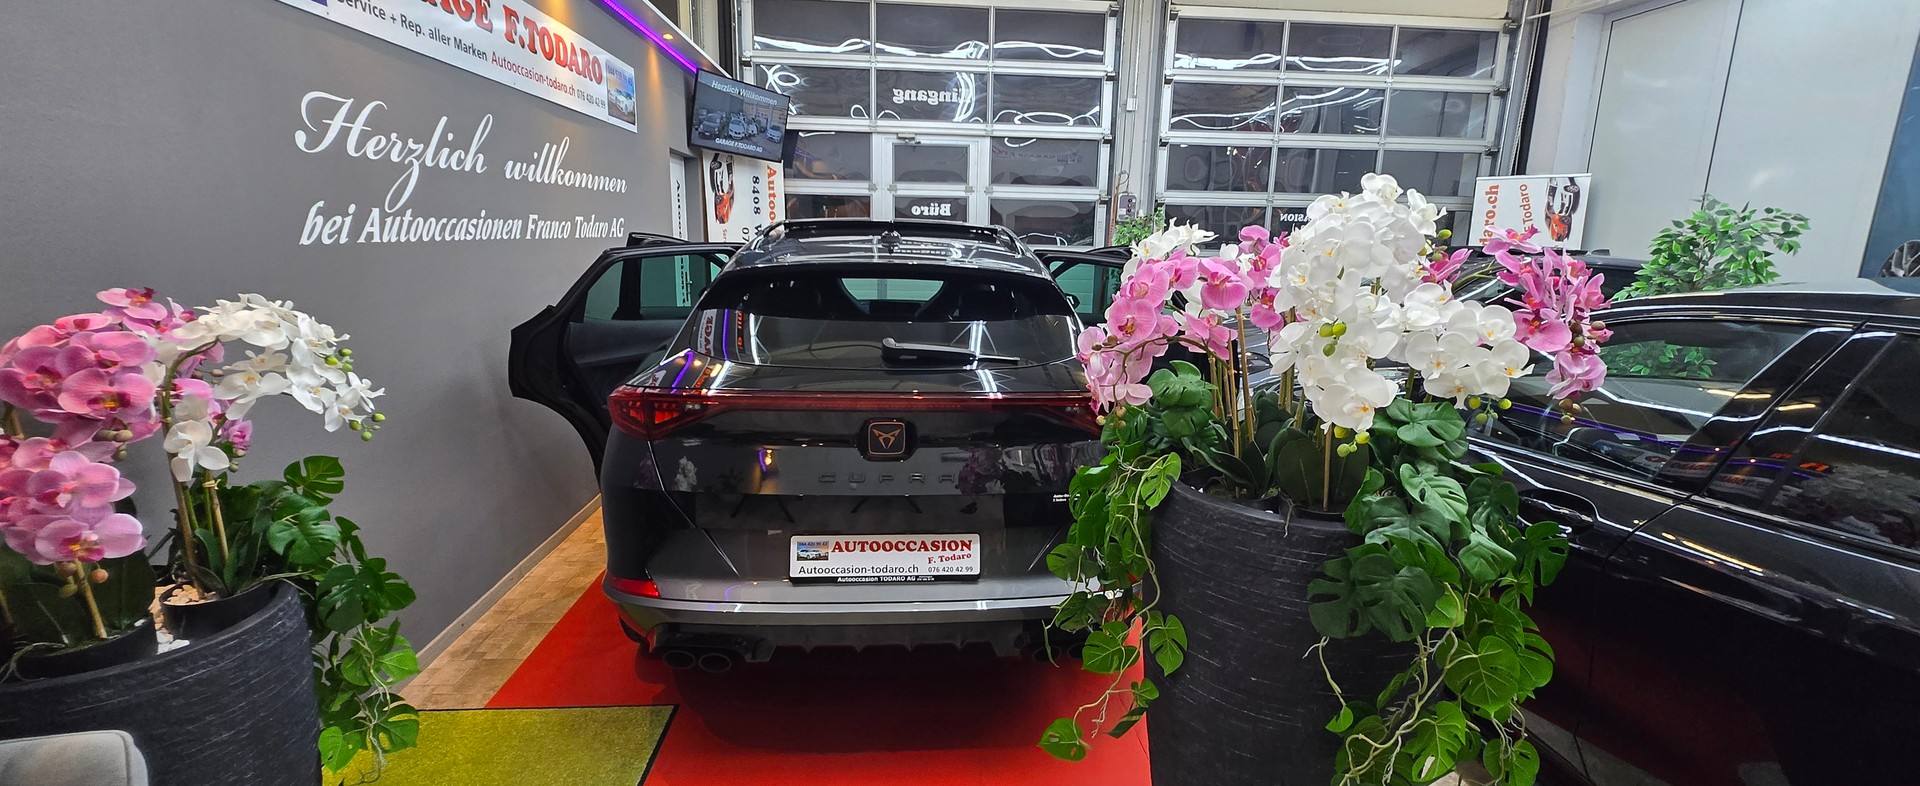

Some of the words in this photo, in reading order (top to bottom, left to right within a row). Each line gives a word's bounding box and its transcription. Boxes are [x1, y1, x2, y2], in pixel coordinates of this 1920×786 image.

[337, 0, 386, 21] ervice
[389, 13, 397, 24] +
[400, 13, 425, 37] Rep.
[428, 27, 451, 47] aller
[454, 36, 488, 61] Marken
[491, 51, 576, 97] Autooccasion-todaro.ch
[502, 4, 603, 85] F.TODARO
[711, 80, 740, 95] Herzlich
[740, 88, 778, 106] Willkommen
[294, 91, 493, 213] Herzlich
[504, 136, 628, 193] willkommen
[715, 137, 734, 147] GARAGE
[752, 176, 760, 215] 8408
[767, 165, 777, 225] Autoo
[1519, 184, 1533, 224] Todaro
[299, 200, 356, 245] bei
[357, 207, 523, 243] Autooccasionen
[526, 214, 571, 240] Franco
[575, 214, 608, 239] Todaro
[609, 217, 625, 238] AG
[819, 472, 956, 483] CUPRA
[831, 540, 972, 553] AUTOOCCASION
[928, 556, 937, 565] F.
[938, 552, 972, 563] Todaro
[798, 564, 919, 574] Autooccasion-todaro.ch
